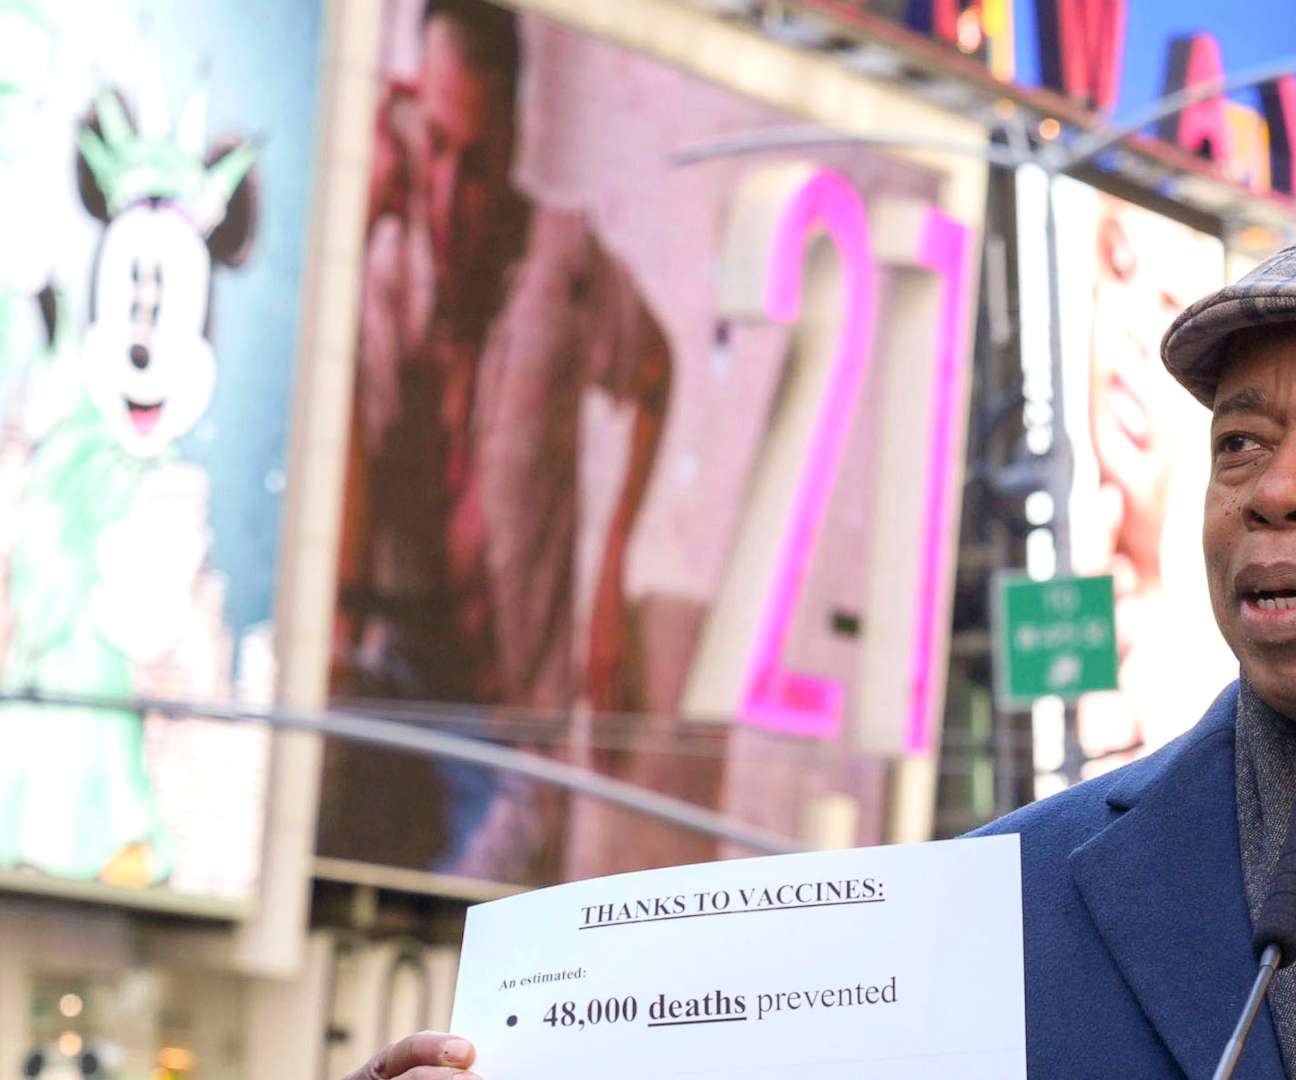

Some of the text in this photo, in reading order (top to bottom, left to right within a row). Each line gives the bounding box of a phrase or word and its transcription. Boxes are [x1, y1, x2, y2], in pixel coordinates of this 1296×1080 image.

[581, 878, 885, 926] THANKS TO VACCINES:
[499, 967, 587, 991] An estimated:
[543, 976, 898, 1031] 48,000 deaths prevented
